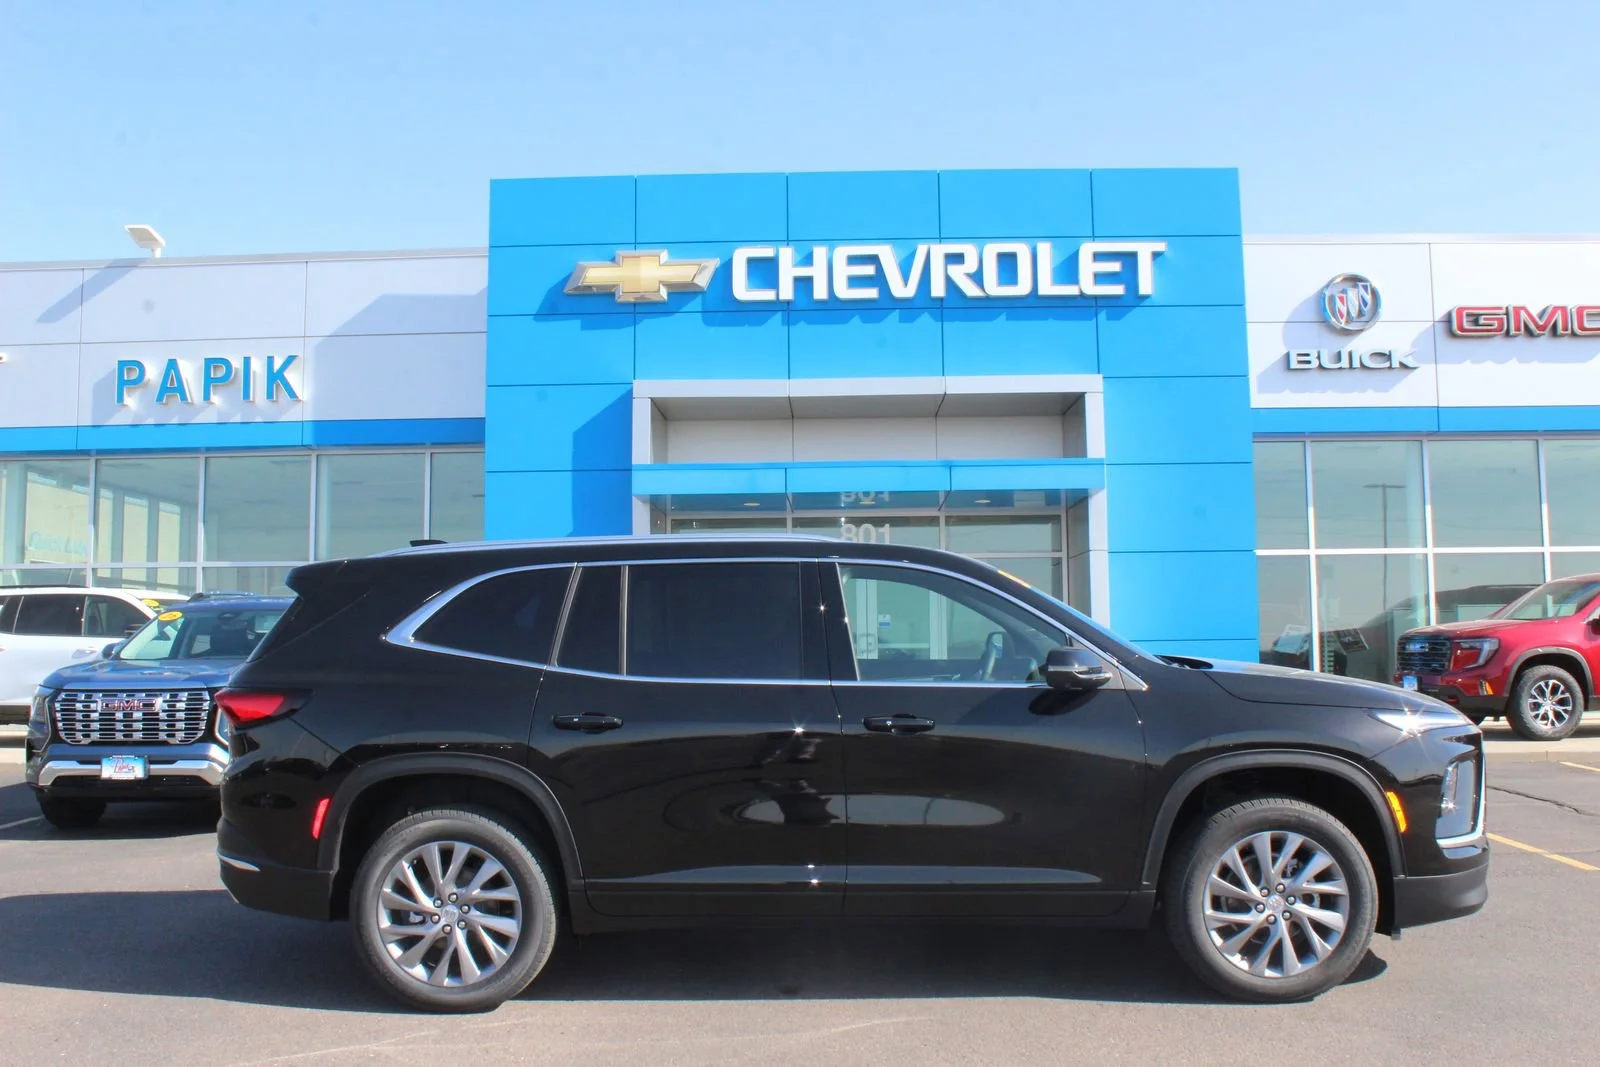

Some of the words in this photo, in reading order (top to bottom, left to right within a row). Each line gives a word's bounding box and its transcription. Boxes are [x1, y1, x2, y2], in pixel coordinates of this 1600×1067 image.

[732, 242, 1167, 301] CHEVROLET
[1287, 348, 1419, 370] BUICK
[116, 354, 303, 405] PAPIK
[840, 523, 890, 545] 801
[100, 698, 158, 712] GMC
